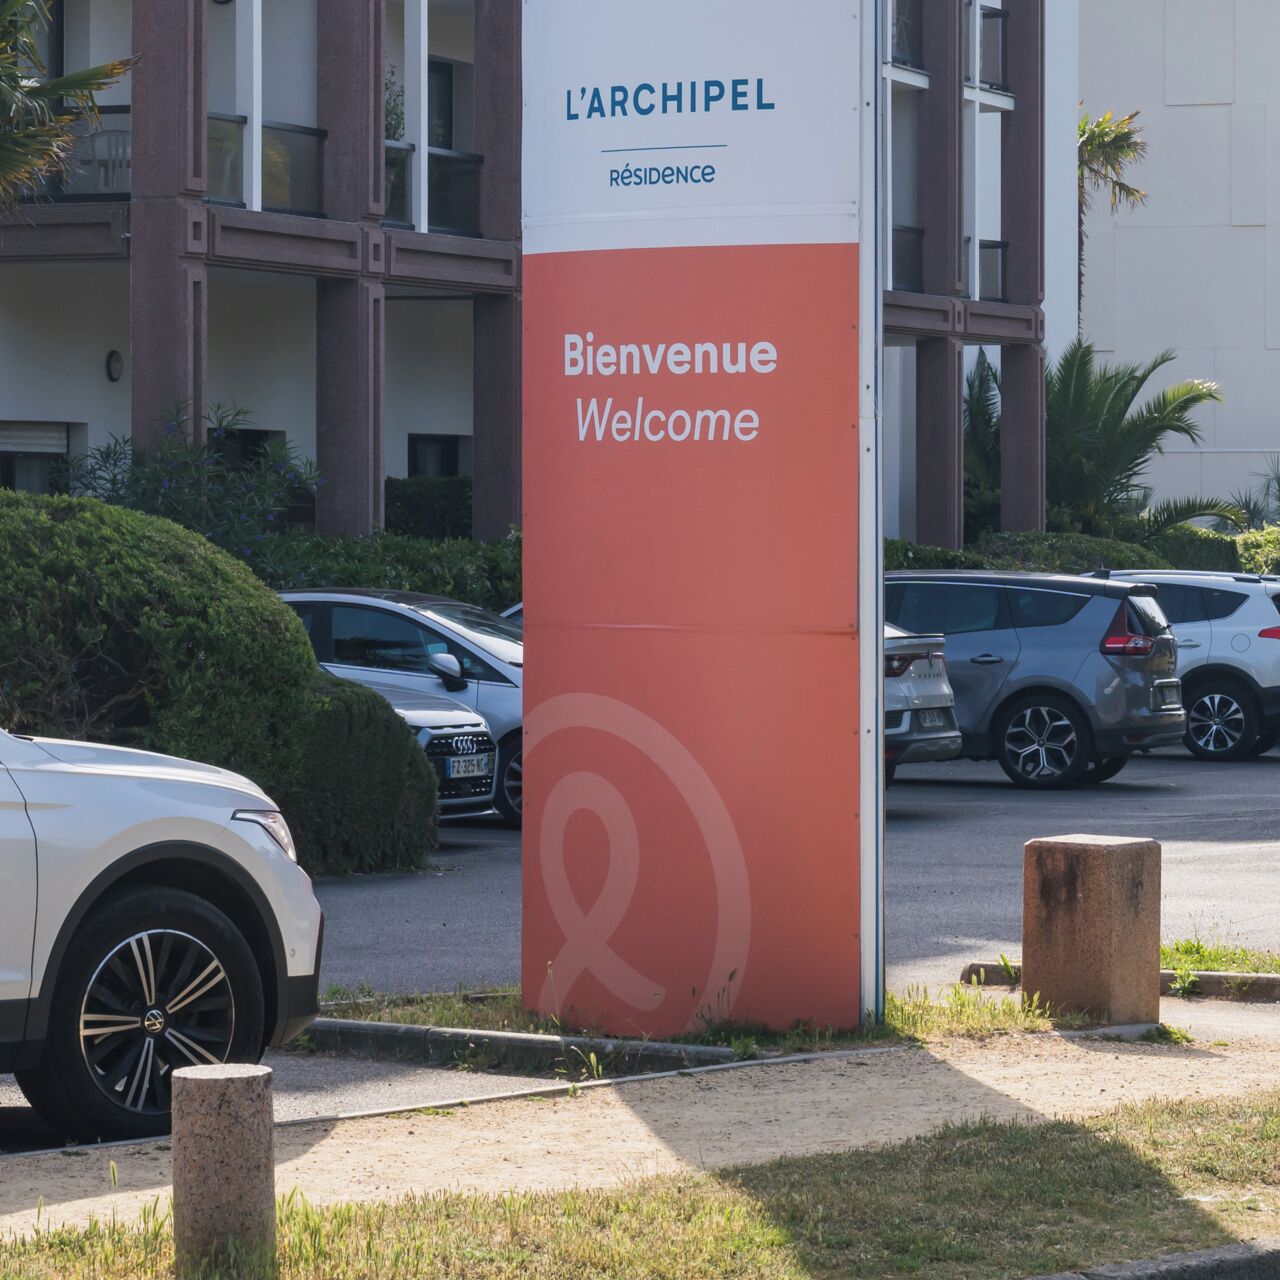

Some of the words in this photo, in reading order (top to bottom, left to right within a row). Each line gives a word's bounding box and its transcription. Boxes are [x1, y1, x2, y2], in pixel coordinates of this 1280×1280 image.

[566, 78, 775, 121] L'ARCHIPEL
[564, 331, 778, 376] Bienvenue
[576, 396, 760, 442] Welcome
